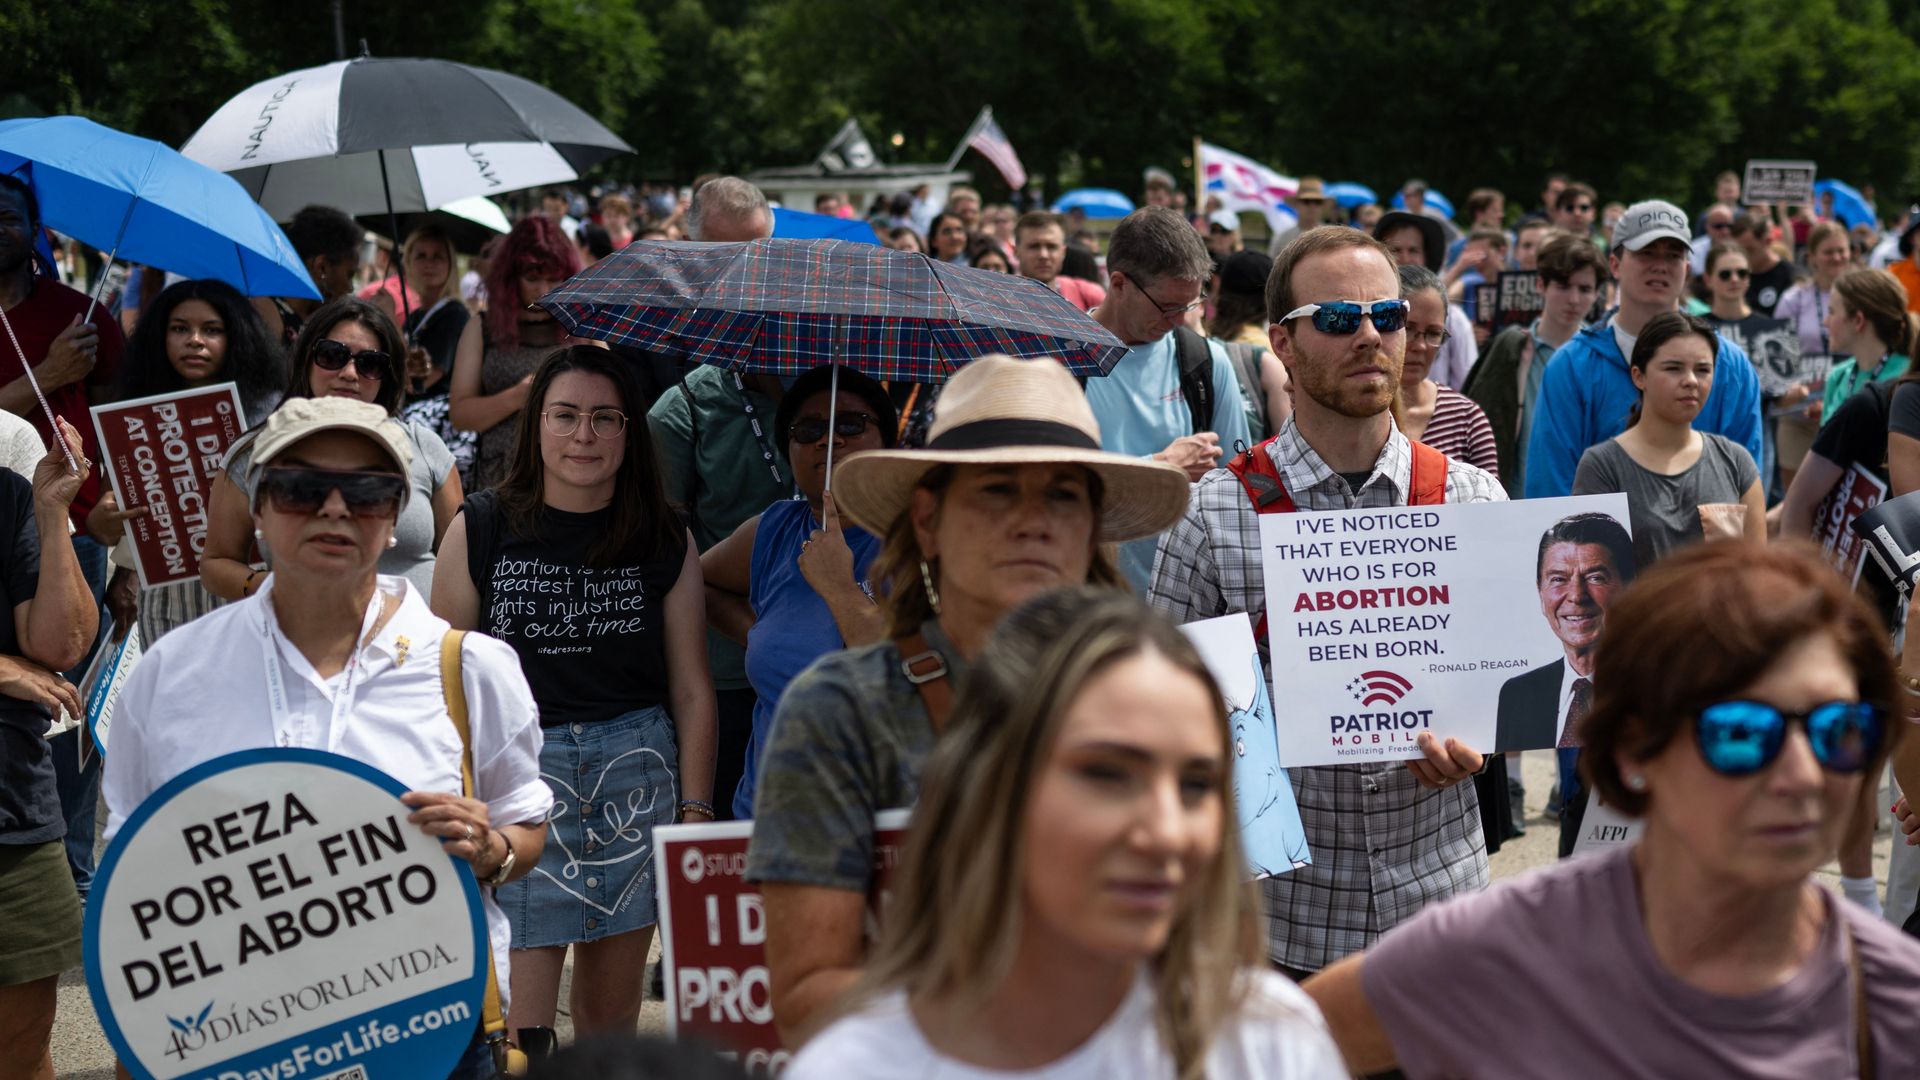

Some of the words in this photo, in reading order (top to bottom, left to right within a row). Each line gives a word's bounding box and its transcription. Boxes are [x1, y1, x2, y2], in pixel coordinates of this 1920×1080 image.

[123, 416, 149, 442] AT
[123, 475, 140, 505] ACTION
[151, 402, 209, 568] PROTECTIO
[133, 445, 187, 576] CONCEPTION
[1296, 518, 1335, 535] I'VE
[1342, 512, 1440, 532] NOTICED
[1276, 542, 1333, 560] THAT
[1340, 535, 1457, 557] EVERYONE
[1302, 565, 1360, 583] WHO
[1367, 563, 1386, 580] IS
[1392, 561, 1436, 578] FOR
[584, 577, 645, 598] human
[1294, 584, 1450, 613] ABORTION
[549, 595, 645, 623] injustice
[491, 618, 515, 641] of
[525, 622, 580, 638] our
[587, 616, 645, 637] time.
[1297, 619, 1342, 637] HAS
[1349, 614, 1451, 634] ALREADY
[537, 646, 593, 655] lifedress.org
[1309, 643, 1368, 662] BEEN
[1376, 639, 1445, 659] BORN.
[1330, 710, 1433, 733] PATRIOT
[1337, 747, 1384, 756] Mobilizing
[1388, 744, 1422, 753] Freedo
[181, 792, 319, 866] REZA
[547, 786, 659, 880] Life
[1588, 824, 1629, 840] AFPI
[130, 874, 242, 941] POR
[247, 853, 313, 901] EL
[318, 815, 408, 877] FIN
[121, 940, 223, 1002] DEL
[238, 864, 437, 966] ABORTO
[280, 978, 344, 1019] POR
[340, 967, 382, 998] LA
